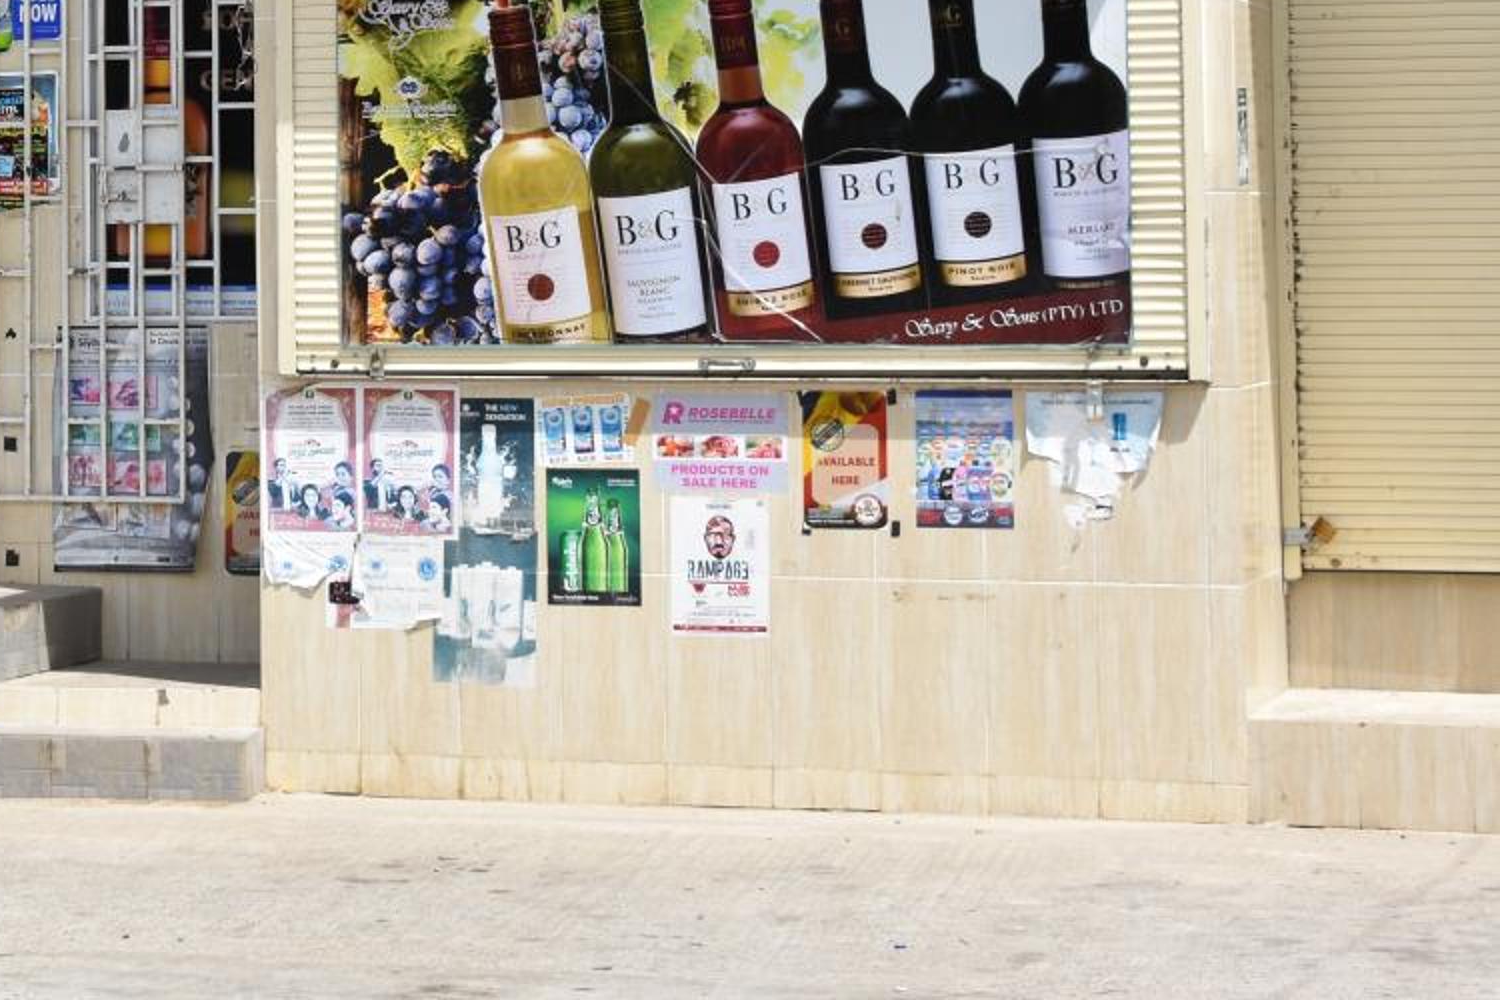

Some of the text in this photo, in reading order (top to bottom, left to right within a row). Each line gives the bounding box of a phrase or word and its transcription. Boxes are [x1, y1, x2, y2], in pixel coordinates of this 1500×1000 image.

[944, 157, 1000, 190] BG
[839, 168, 896, 201] BG
[731, 186, 788, 221] BG
[947, 266, 984, 276] PINOT
[961, 313, 986, 332] &
[1090, 298, 1125, 317] LTD
[688, 407, 776, 420] ROSEBELLE
[818, 457, 876, 467] AVAILABLE
[671, 463, 769, 476] PRODUCTS ON
[681, 477, 758, 489] SALE HERE
[831, 475, 860, 485] HERE
